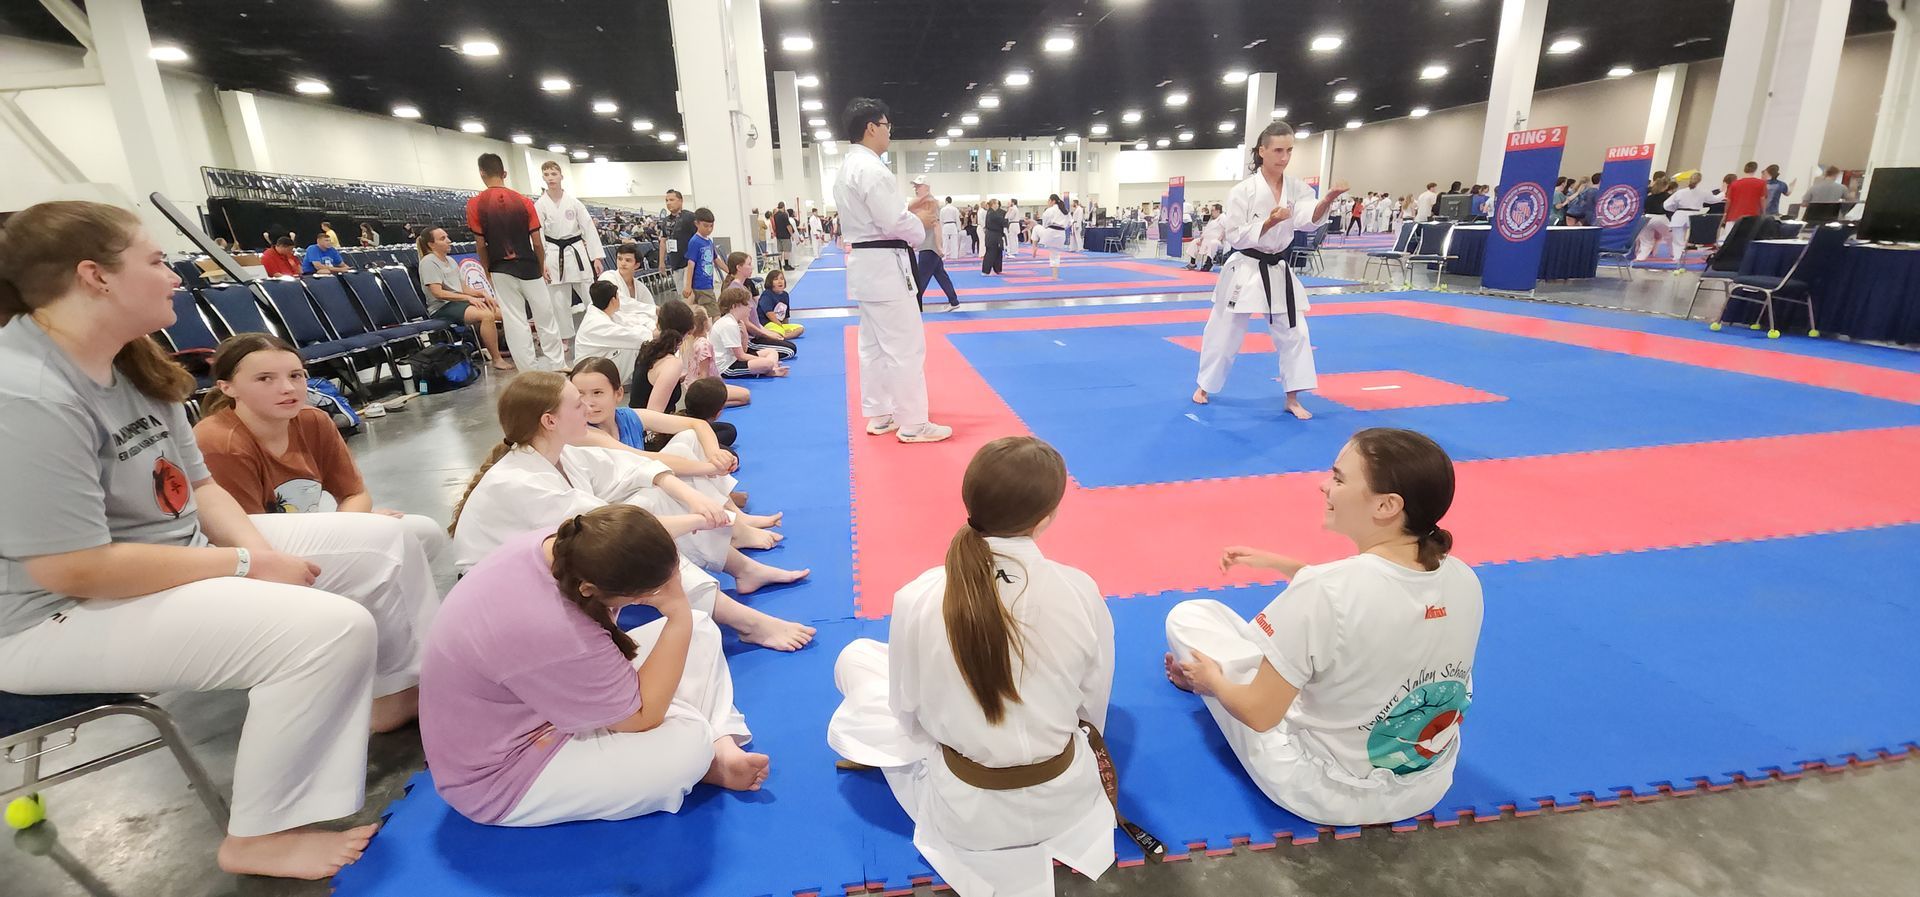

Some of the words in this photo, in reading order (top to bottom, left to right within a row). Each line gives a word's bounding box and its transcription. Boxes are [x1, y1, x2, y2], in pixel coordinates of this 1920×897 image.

[1510, 130, 1547, 147] RING
[1551, 128, 1562, 142] 2
[1608, 147, 1638, 158] RING
[1641, 145, 1650, 156] 3
[1402, 669, 1437, 692] Valley
